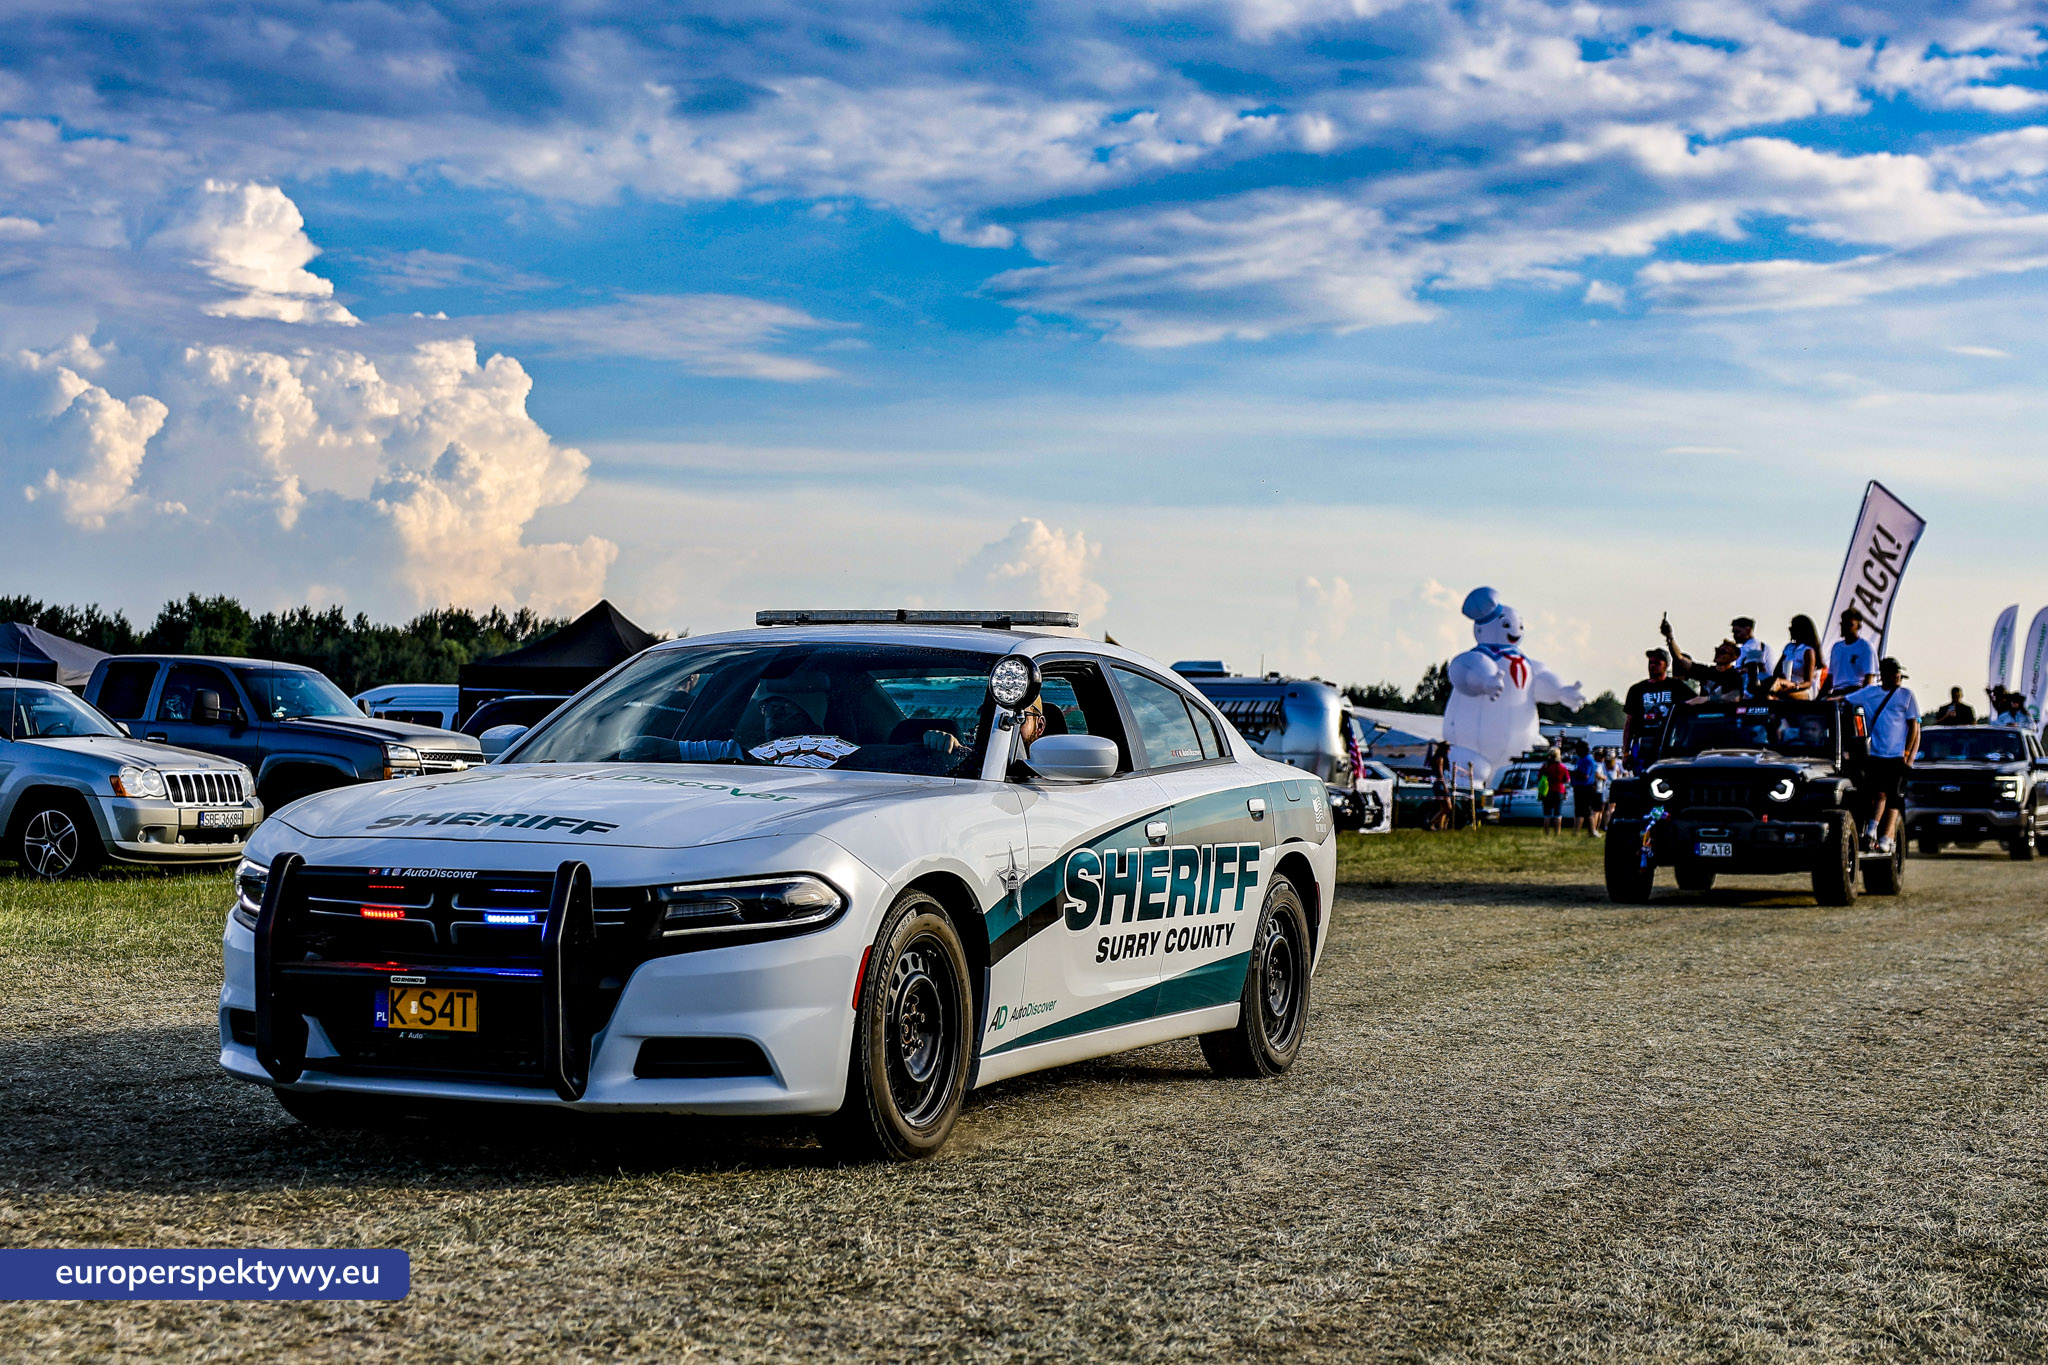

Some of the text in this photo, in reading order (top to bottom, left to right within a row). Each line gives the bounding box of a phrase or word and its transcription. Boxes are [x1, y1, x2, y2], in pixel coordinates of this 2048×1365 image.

[204, 813, 219, 825] SBE
[366, 812, 620, 835] SHERIFF
[402, 868, 477, 879] AutoDiscover
[1064, 842, 1261, 934] SHERIFF
[1096, 922, 1235, 963] SURRY COUNTY
[376, 1012, 387, 1021] PL
[389, 989, 474, 1028] K S4T
[987, 1000, 1057, 1033] AD AutoDiscover
